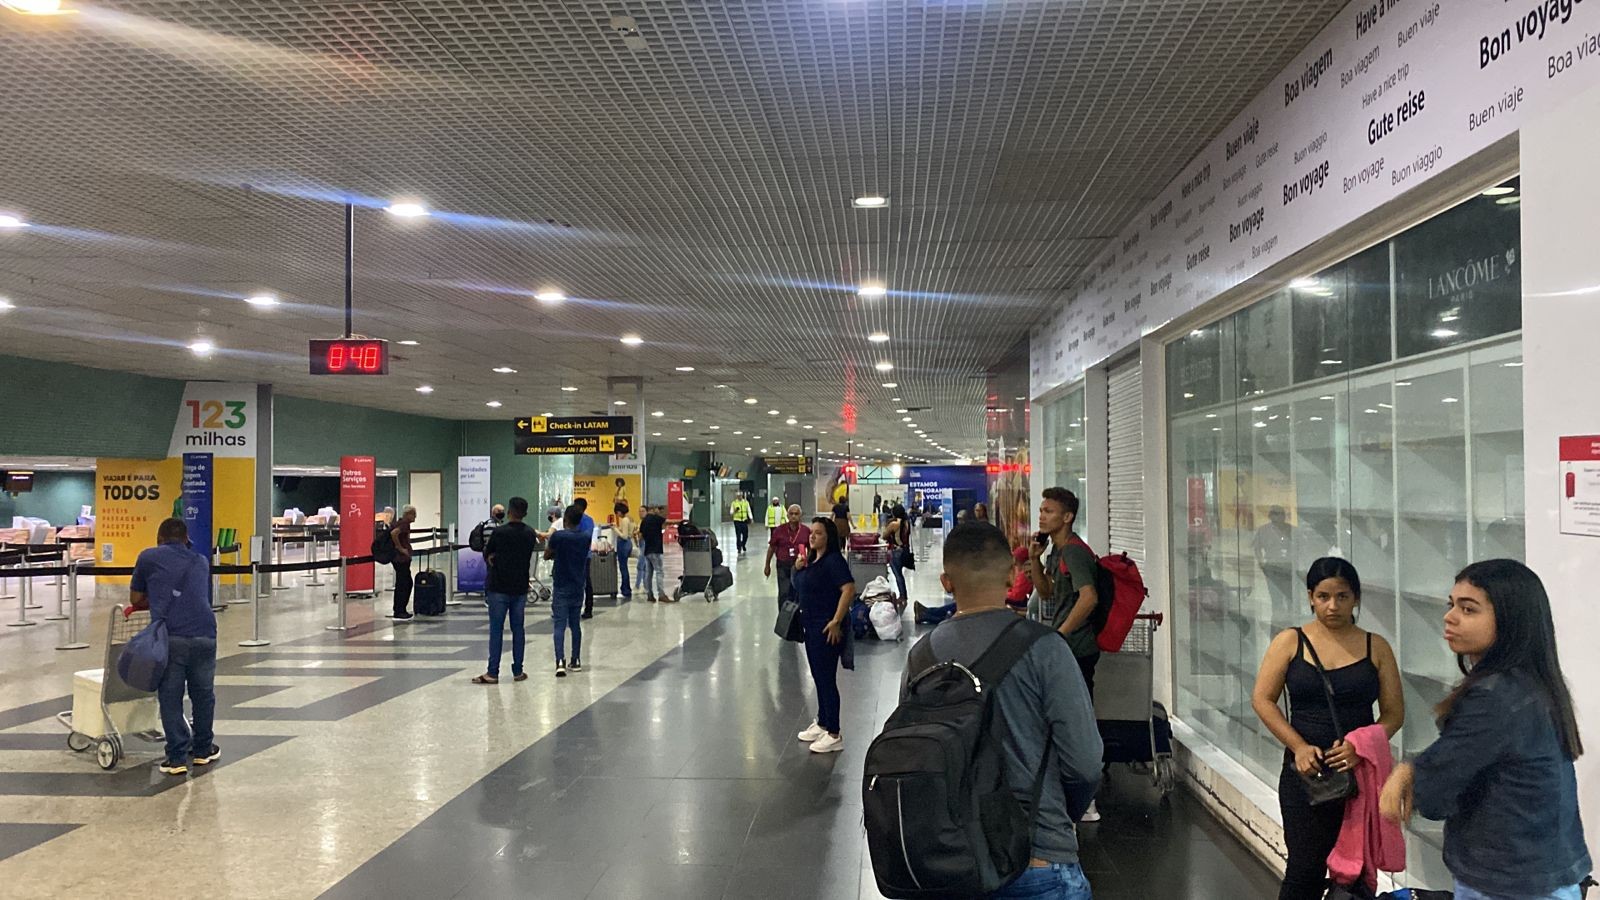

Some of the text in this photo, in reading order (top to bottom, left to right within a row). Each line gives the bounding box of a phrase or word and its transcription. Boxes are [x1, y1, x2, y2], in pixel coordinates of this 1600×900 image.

[1356, 4, 1377, 40] Have
[1379, 0, 1385, 18] a
[1397, 22, 1418, 48] Buen
[1420, 2, 1440, 28] viaje
[1480, 0, 1581, 70] Bon voyag
[1284, 48, 1332, 108] Boa viagem
[1340, 45, 1380, 88] Boa viagem
[1362, 63, 1410, 109] Have a nice trip
[1548, 51, 1572, 78] Boa
[1368, 90, 1425, 145] Gute reise
[1469, 86, 1524, 132] Buen viaje
[1226, 116, 1259, 162] Buen viaje
[1283, 160, 1330, 206] Bon voyage
[1343, 157, 1384, 194] Bon voyage
[1392, 144, 1442, 186] Buon viaggio
[1230, 224, 1240, 243] Bon
[1242, 206, 1264, 236] voyage
[1428, 254, 1500, 300] LANCÔME
[186, 400, 246, 428] 123
[186, 431, 246, 446] milhas
[103, 485, 160, 500] TODOS
